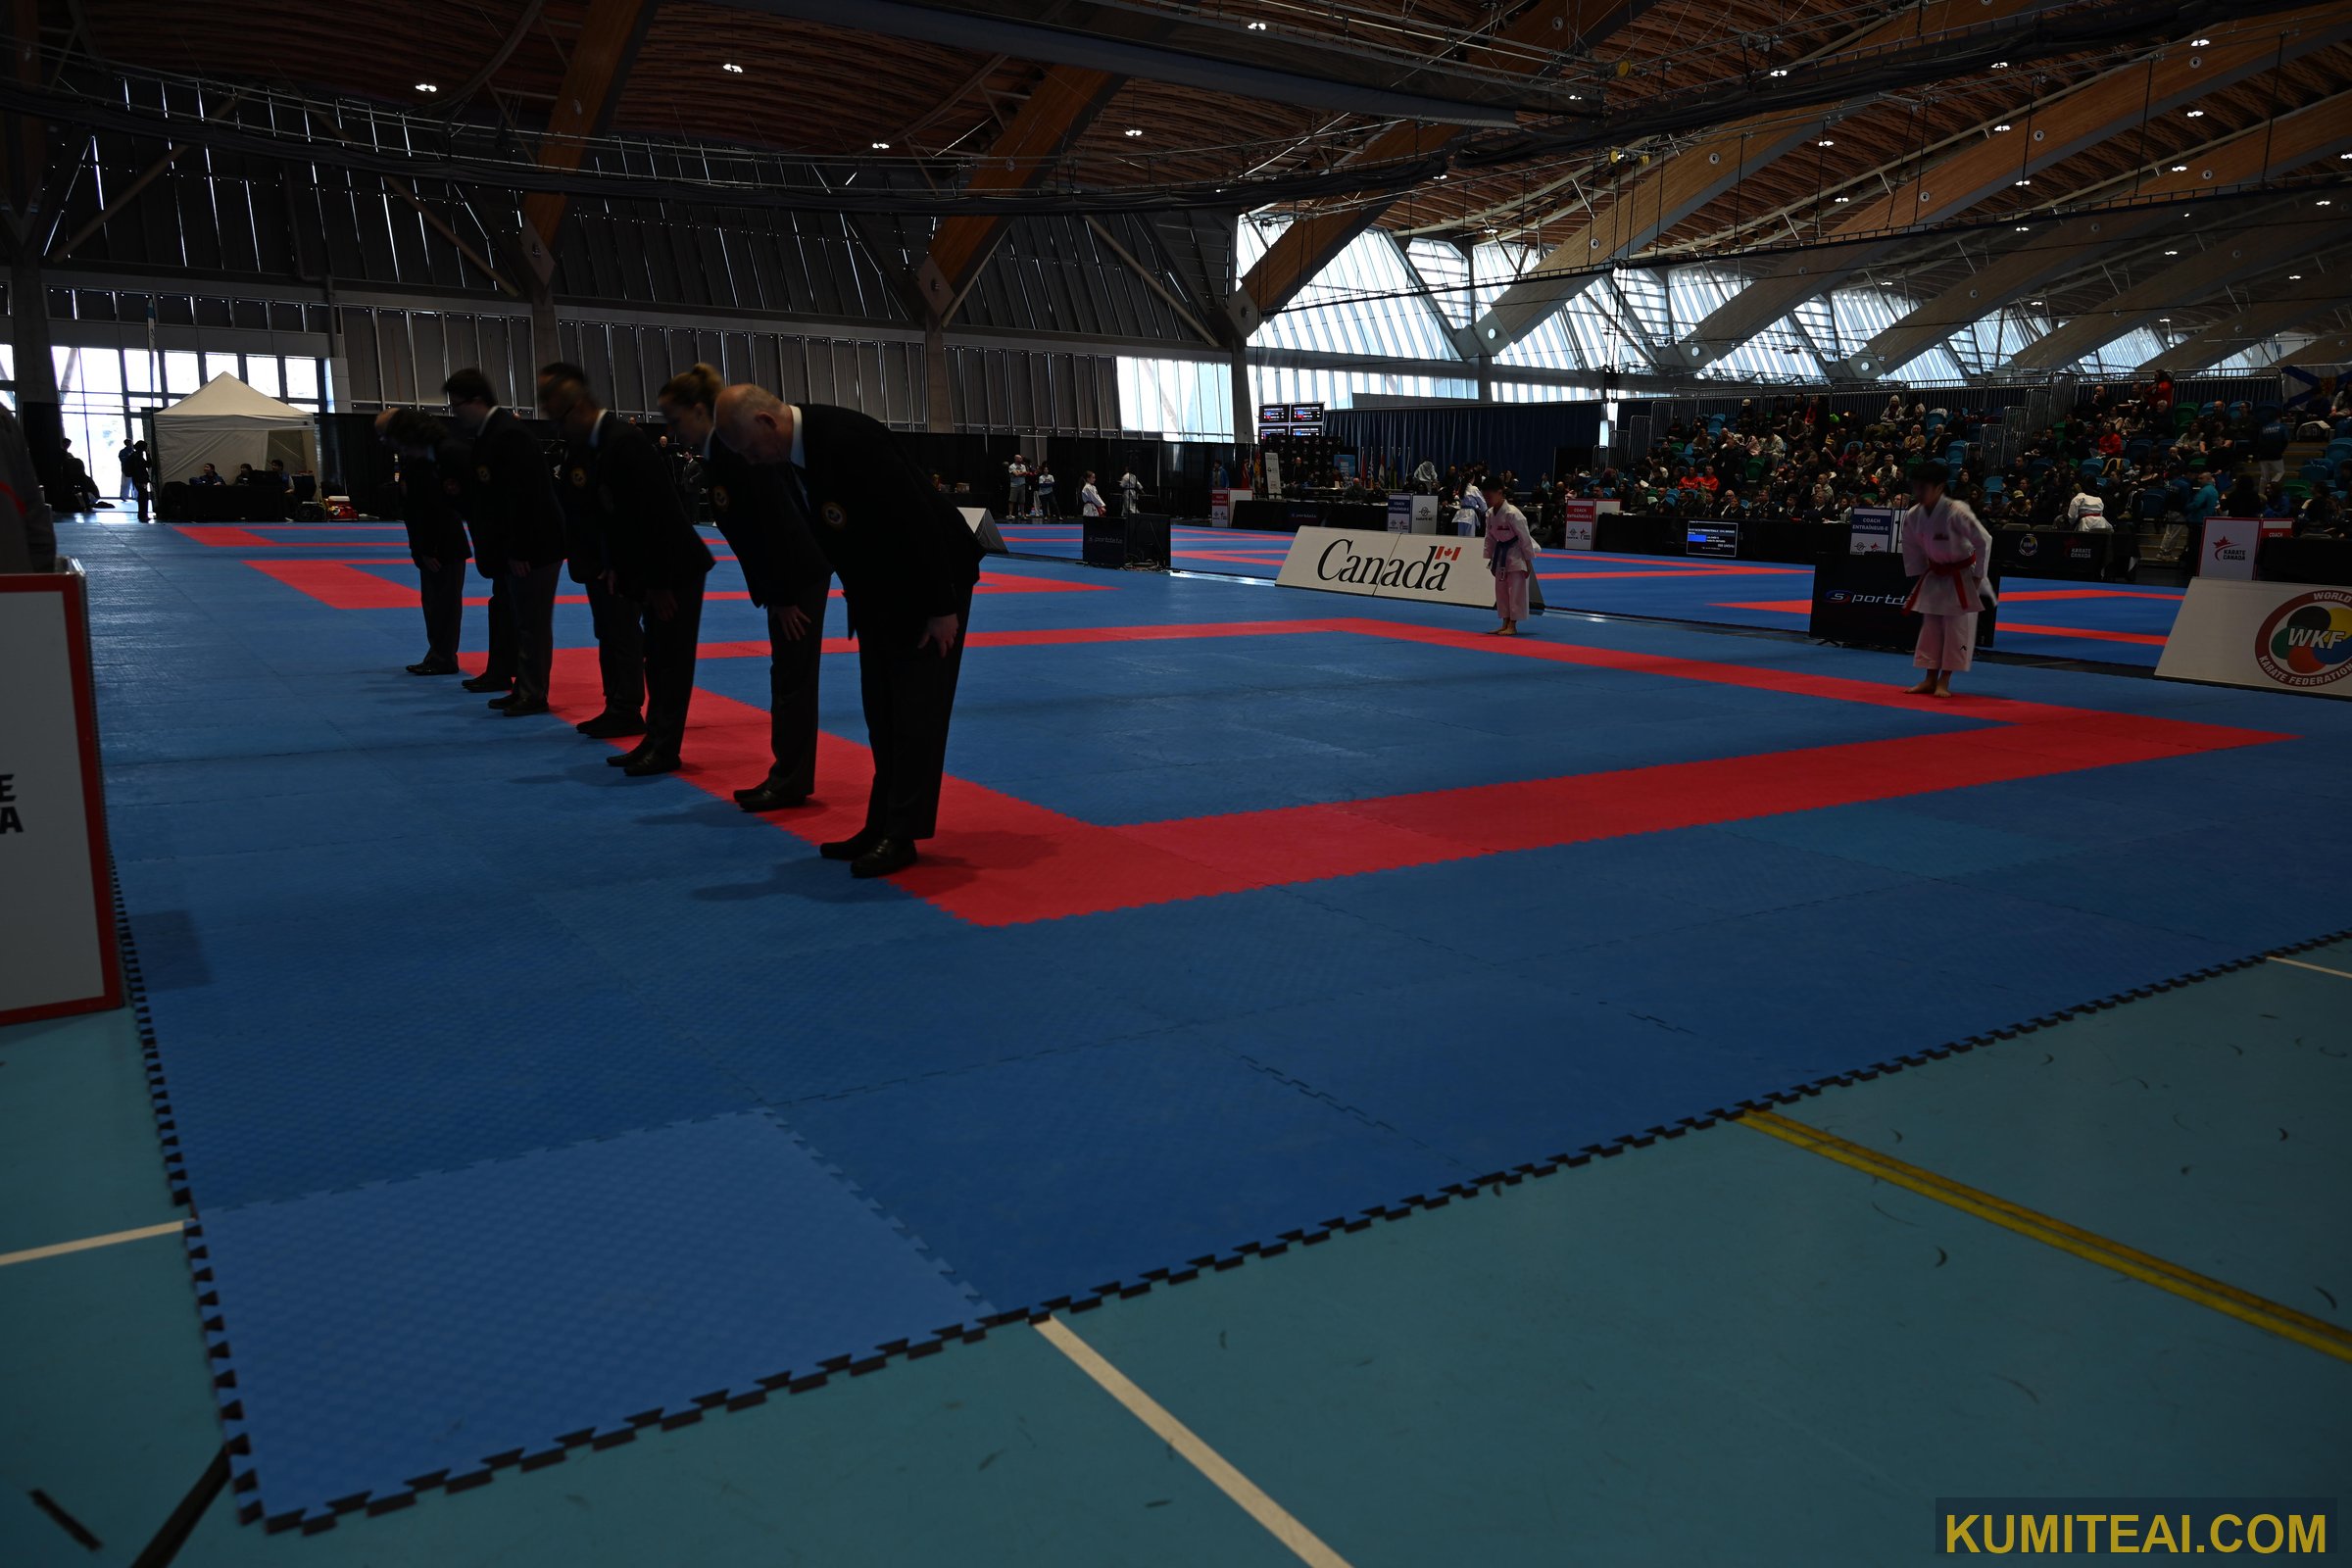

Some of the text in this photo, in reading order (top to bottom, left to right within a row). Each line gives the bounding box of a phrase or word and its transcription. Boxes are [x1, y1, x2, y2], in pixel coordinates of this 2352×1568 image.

[1317, 539, 1450, 591] Canada
[2314, 592, 2352, 602] WORLD
[2288, 628, 2344, 649] WKF
[2259, 656, 2352, 685] KARATE FEDERATION
